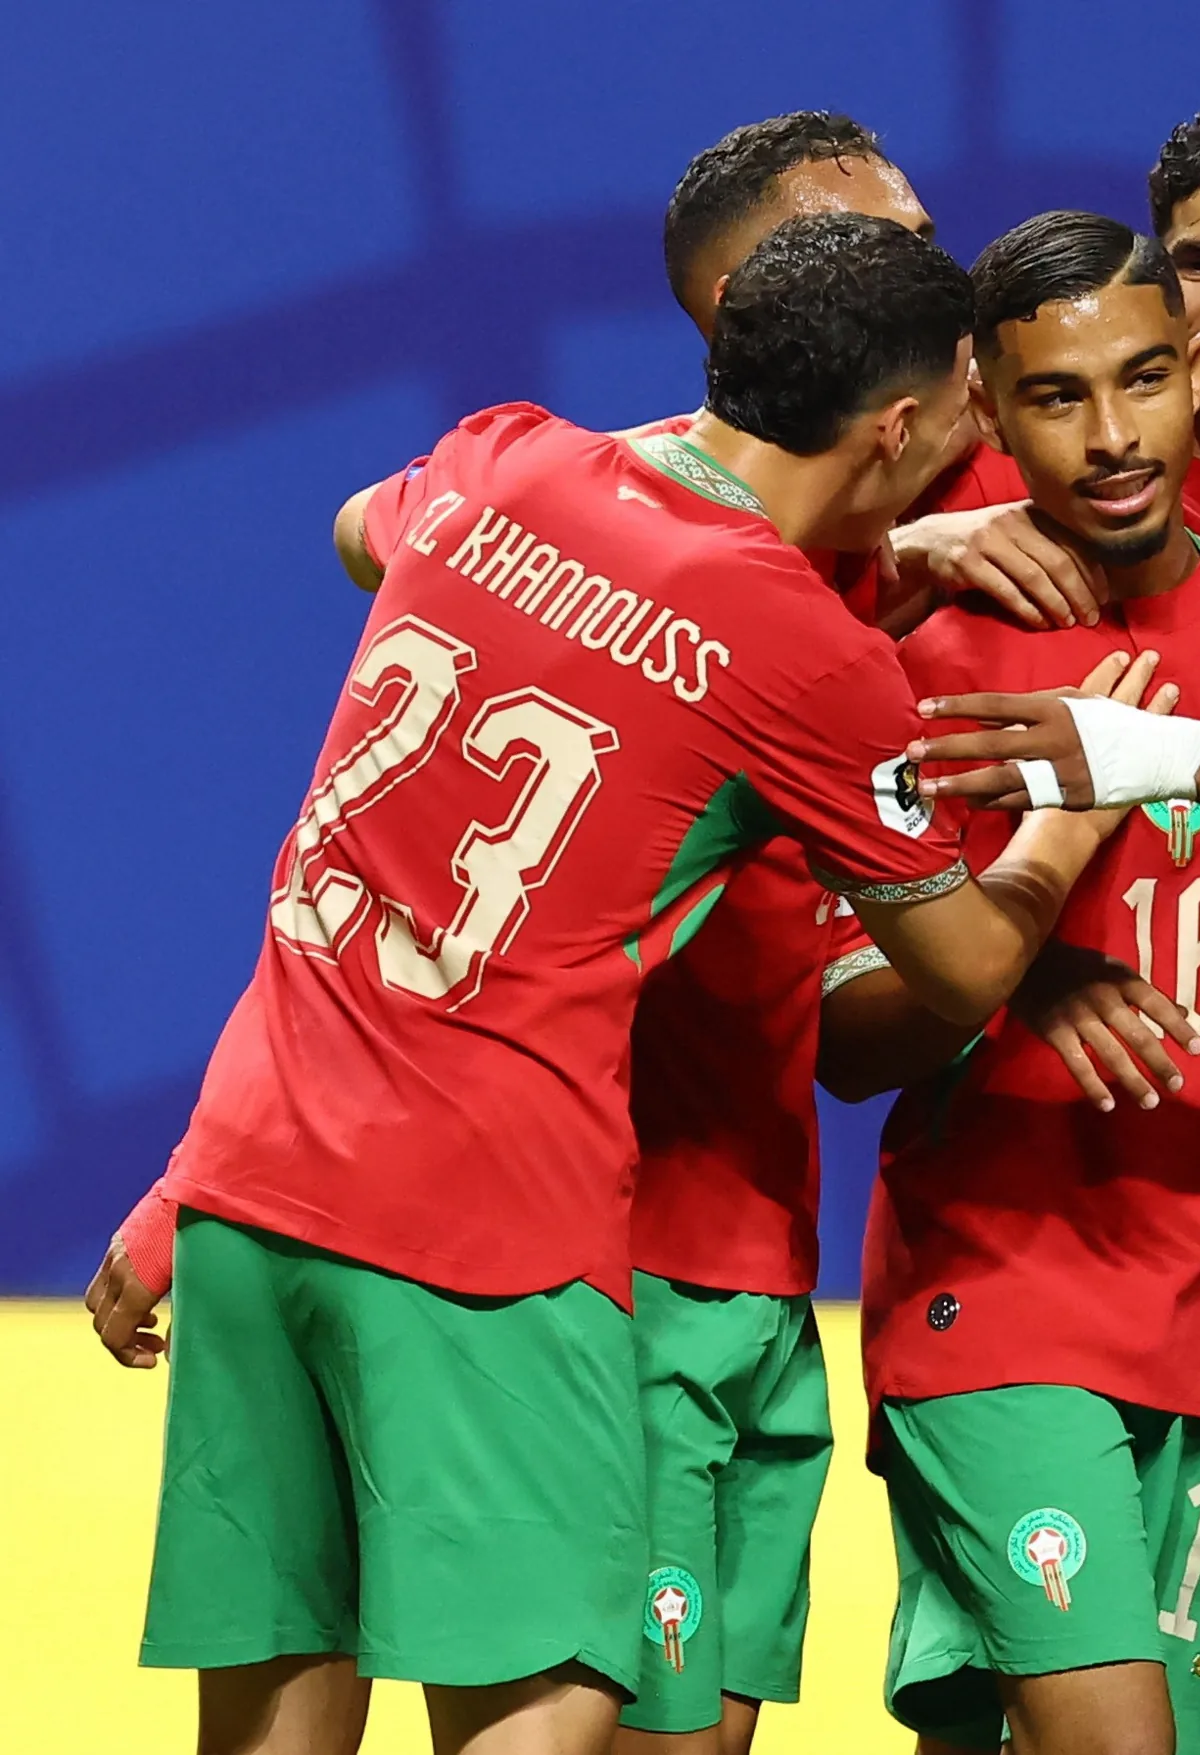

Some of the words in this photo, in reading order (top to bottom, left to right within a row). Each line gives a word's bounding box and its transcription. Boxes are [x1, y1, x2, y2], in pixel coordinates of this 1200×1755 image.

[405, 490, 466, 556] EL
[445, 506, 731, 702] KHANNOUSS
[271, 613, 621, 1013] 23
